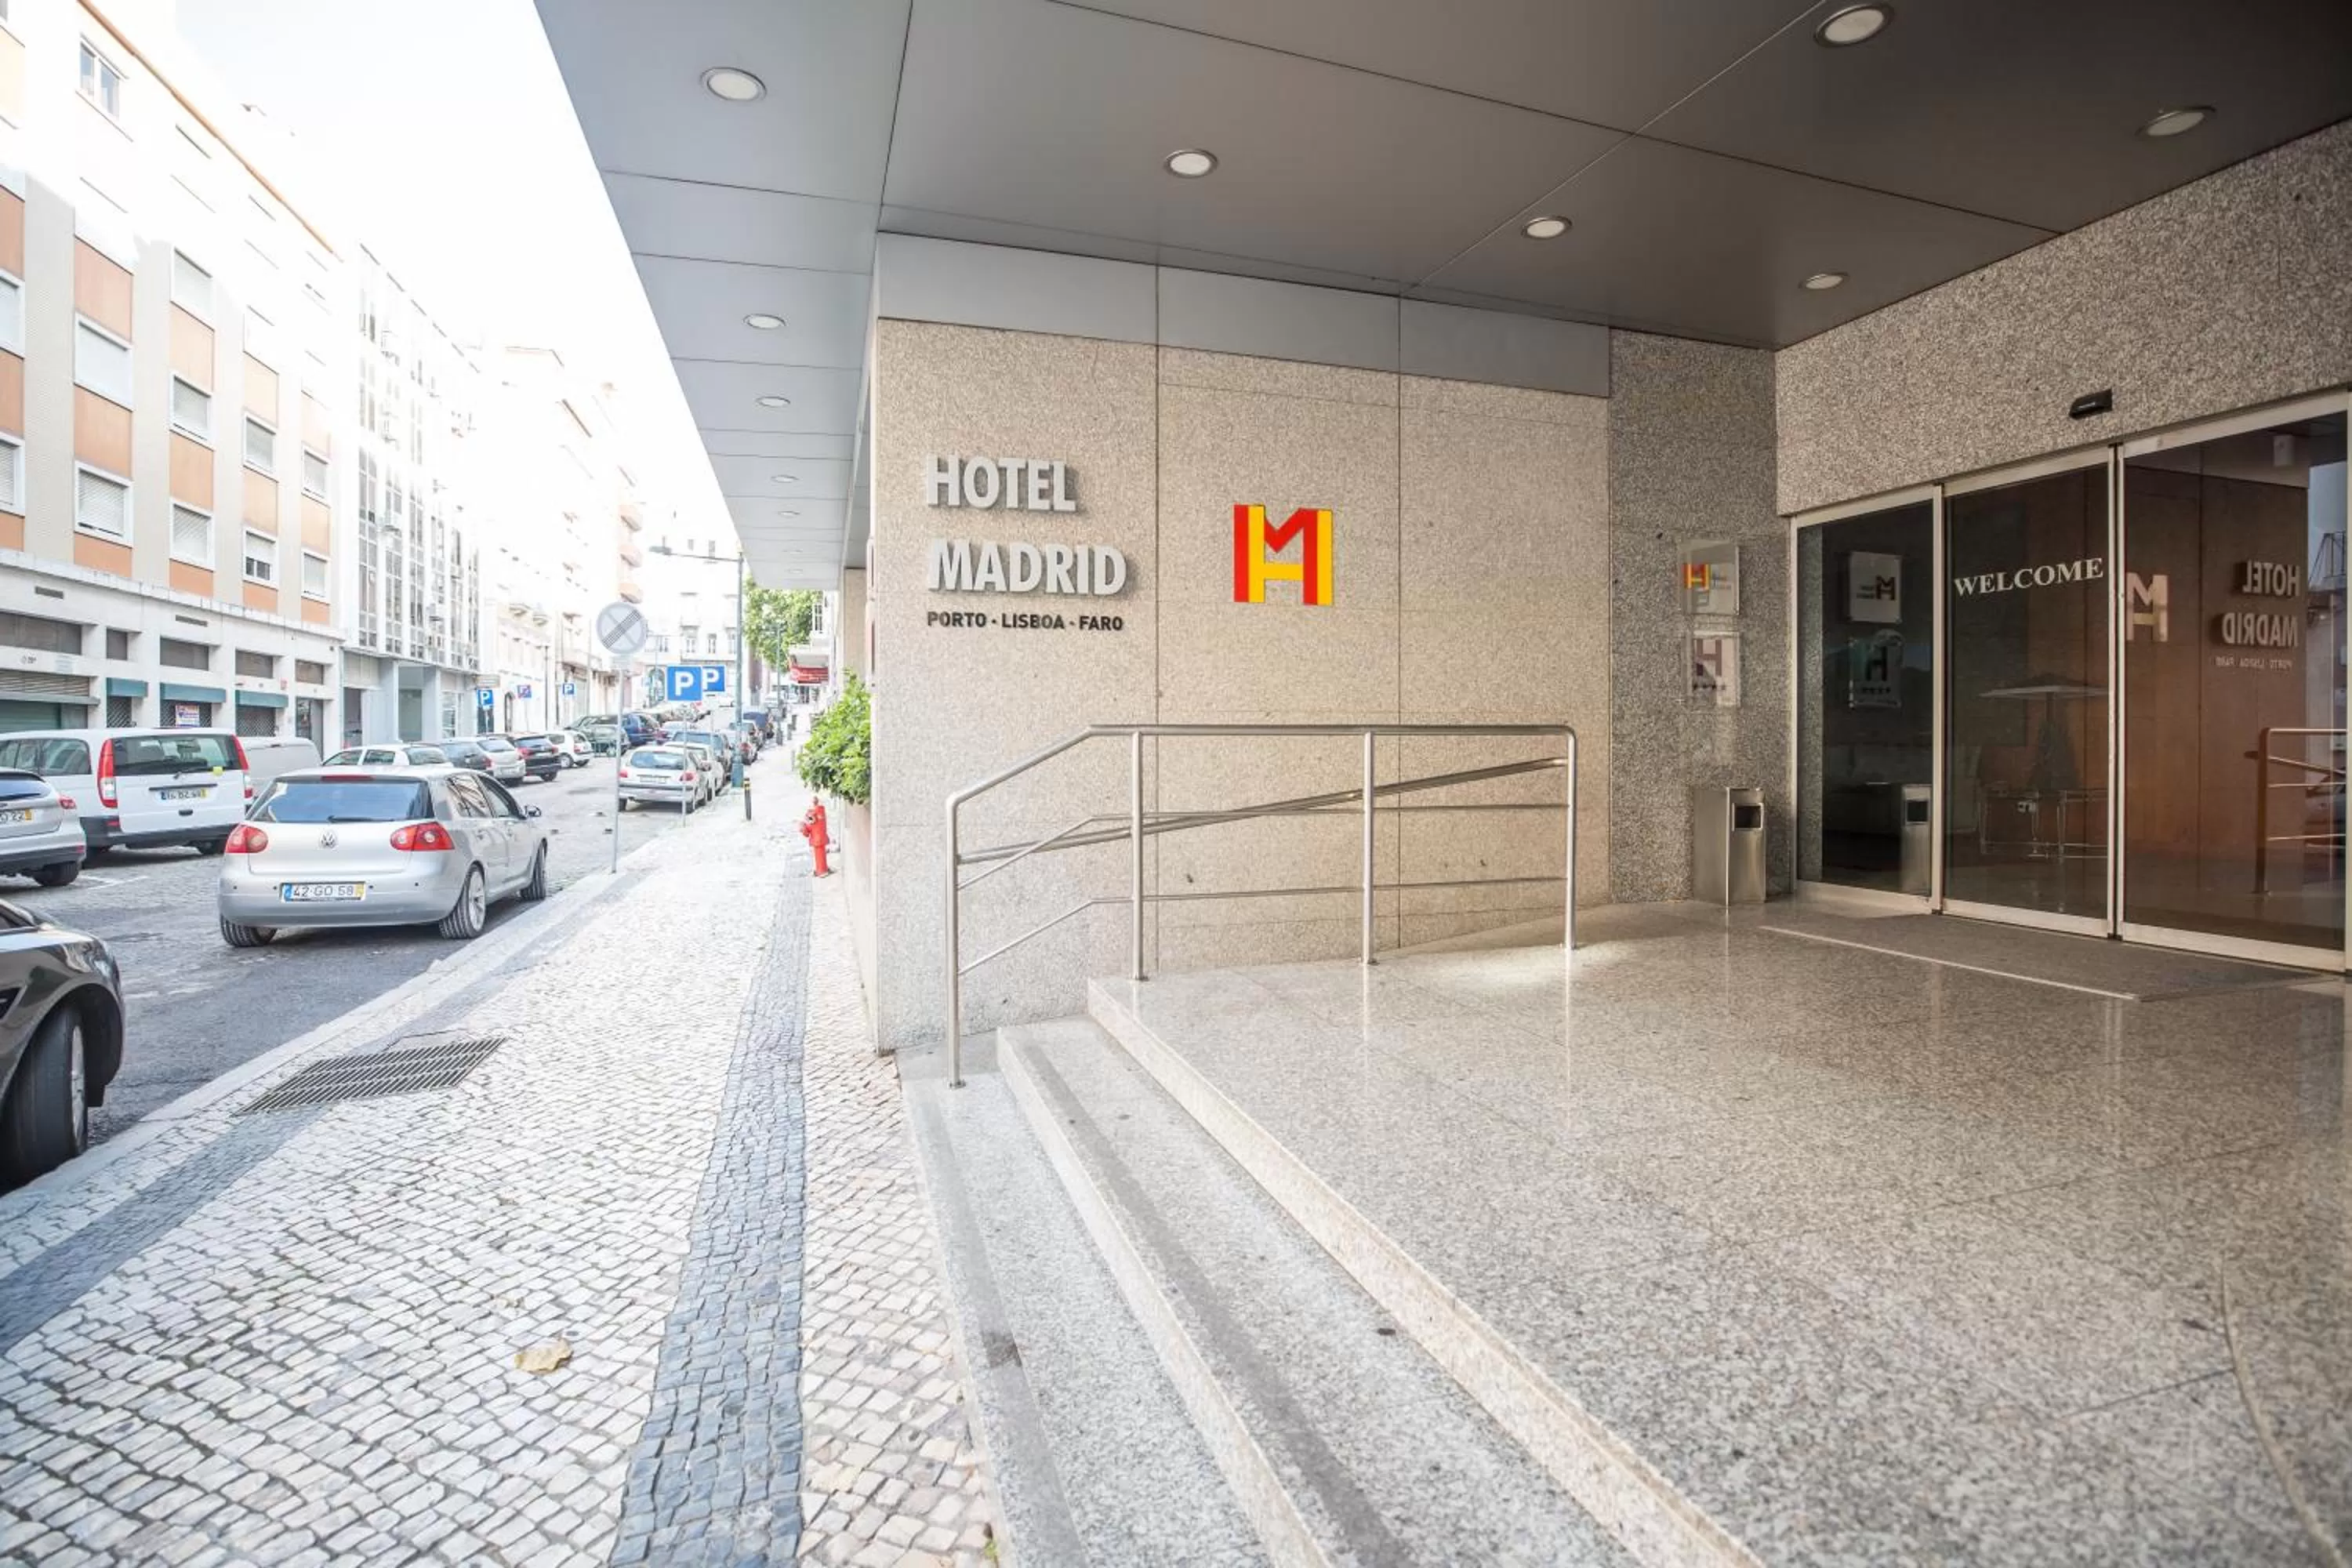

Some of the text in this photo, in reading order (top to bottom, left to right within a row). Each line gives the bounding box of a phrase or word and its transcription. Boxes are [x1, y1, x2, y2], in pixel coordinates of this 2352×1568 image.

[927, 455, 1076, 511] HOTEL
[928, 539, 1127, 595] MADRID
[1954, 557, 2103, 597] WELCOME
[927, 611, 1123, 631] PORTO LISBOA FARO
[675, 671, 694, 696] P
[702, 669, 719, 690] P
[481, 691, 490, 705] P
